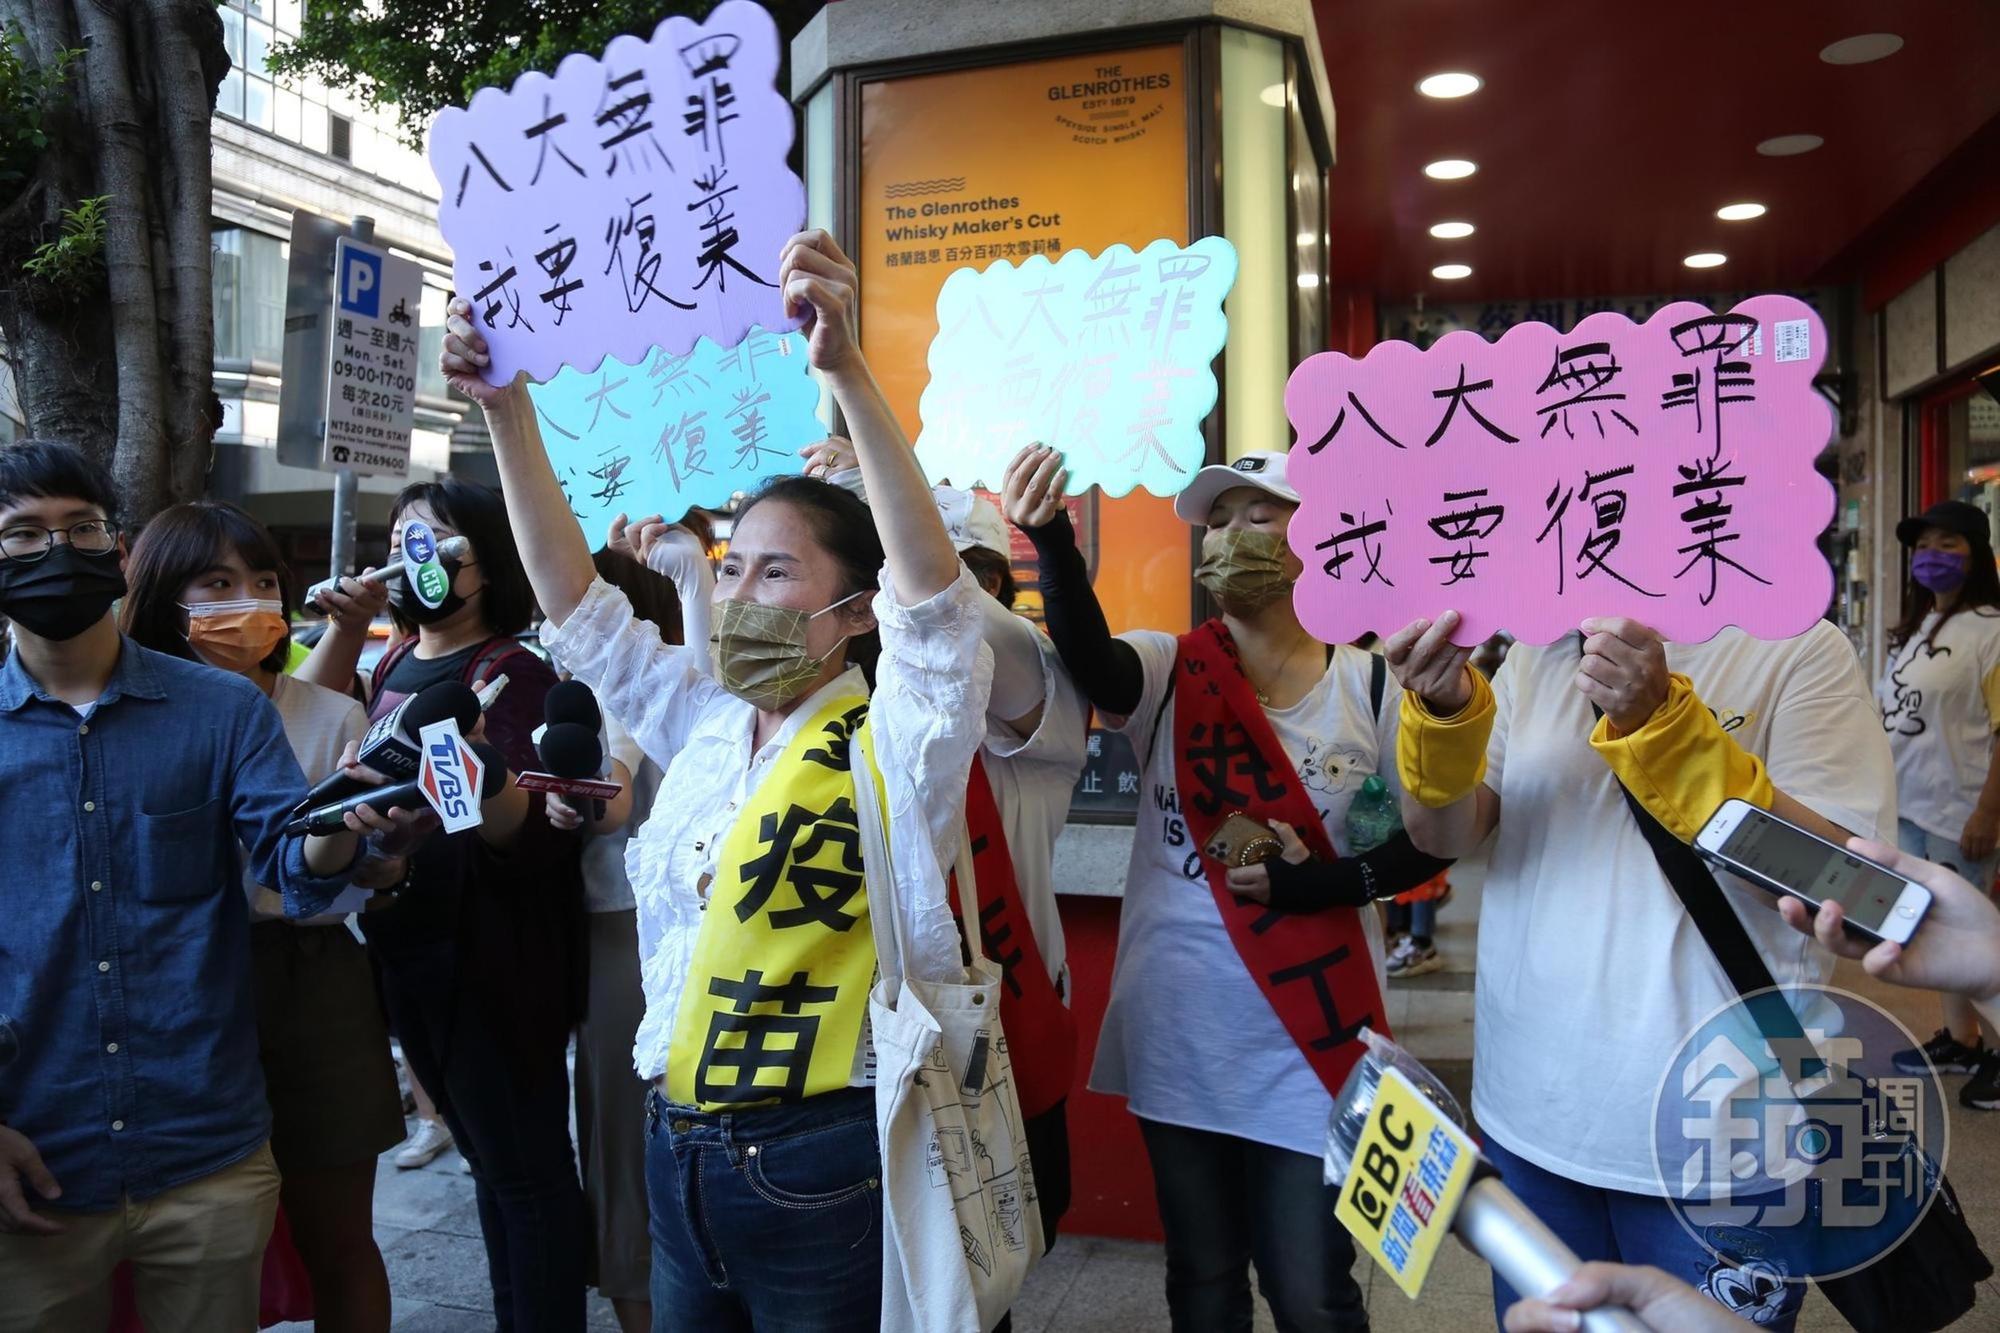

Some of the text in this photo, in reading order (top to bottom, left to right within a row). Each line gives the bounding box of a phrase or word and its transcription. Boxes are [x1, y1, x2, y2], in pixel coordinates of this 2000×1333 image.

[1095, 65, 1122, 78] THE
[1048, 73, 1170, 101] GLENROTHES
[456, 33, 742, 208] 八大無罪
[1056, 115, 1098, 132] SPEYSIDE
[1141, 103, 1164, 122] MALT
[885, 196, 1020, 221] The Glenrothes
[886, 225, 948, 242] Whisky
[1028, 213, 1061, 228] Cut
[473, 168, 780, 333] 我要復業
[886, 238, 1061, 267] 格蘭路思 百分百初次雪莉桶
[348, 261, 374, 304] P
[337, 318, 416, 356] 週一至週六
[334, 360, 414, 392] 09:00-17:00
[1308, 314, 1759, 461] 八大無罪
[342, 384, 404, 413] 每次20元
[331, 420, 408, 443] NT$20 PER STAY
[352, 451, 404, 469] 27269600
[1315, 458, 1773, 606] 我要復業
[421, 569, 442, 598] CTS
[429, 733, 468, 819] TVBS
[1163, 816, 1185, 847] IS
